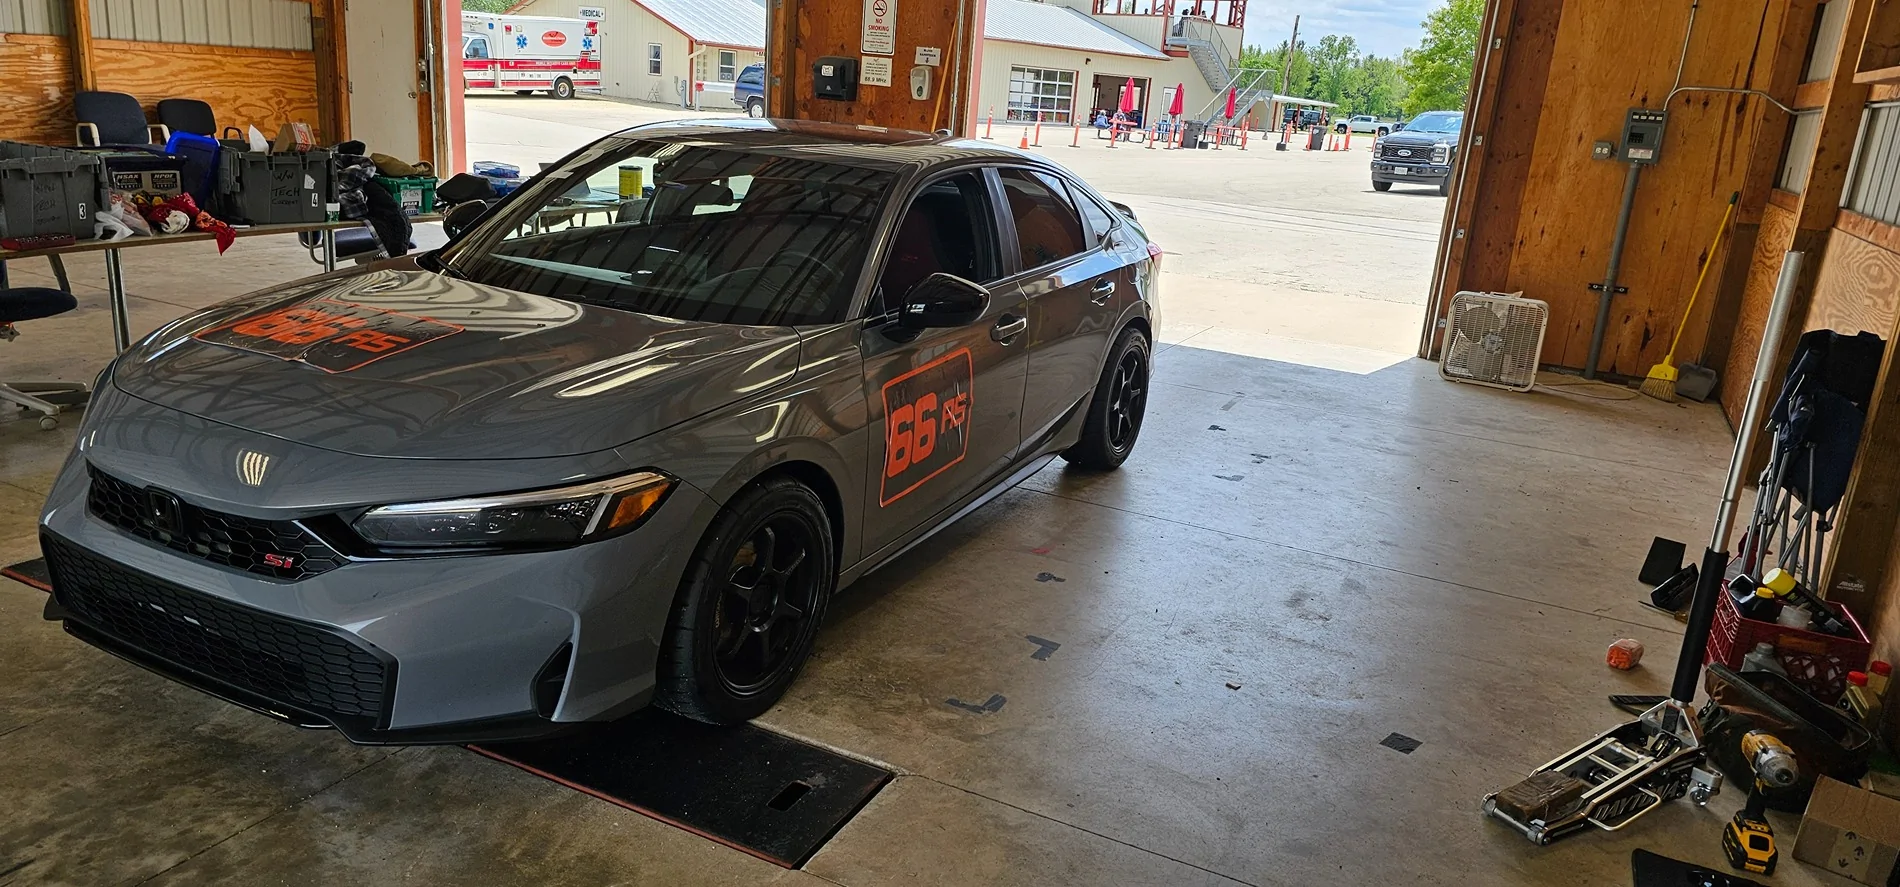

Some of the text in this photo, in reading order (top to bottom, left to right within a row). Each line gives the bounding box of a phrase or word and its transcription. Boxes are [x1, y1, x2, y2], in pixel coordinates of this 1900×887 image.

[582, 9, 601, 17] MEDICAL
[272, 186, 300, 197] TECH
[80, 204, 86, 218] 3
[886, 392, 937, 478] 66
